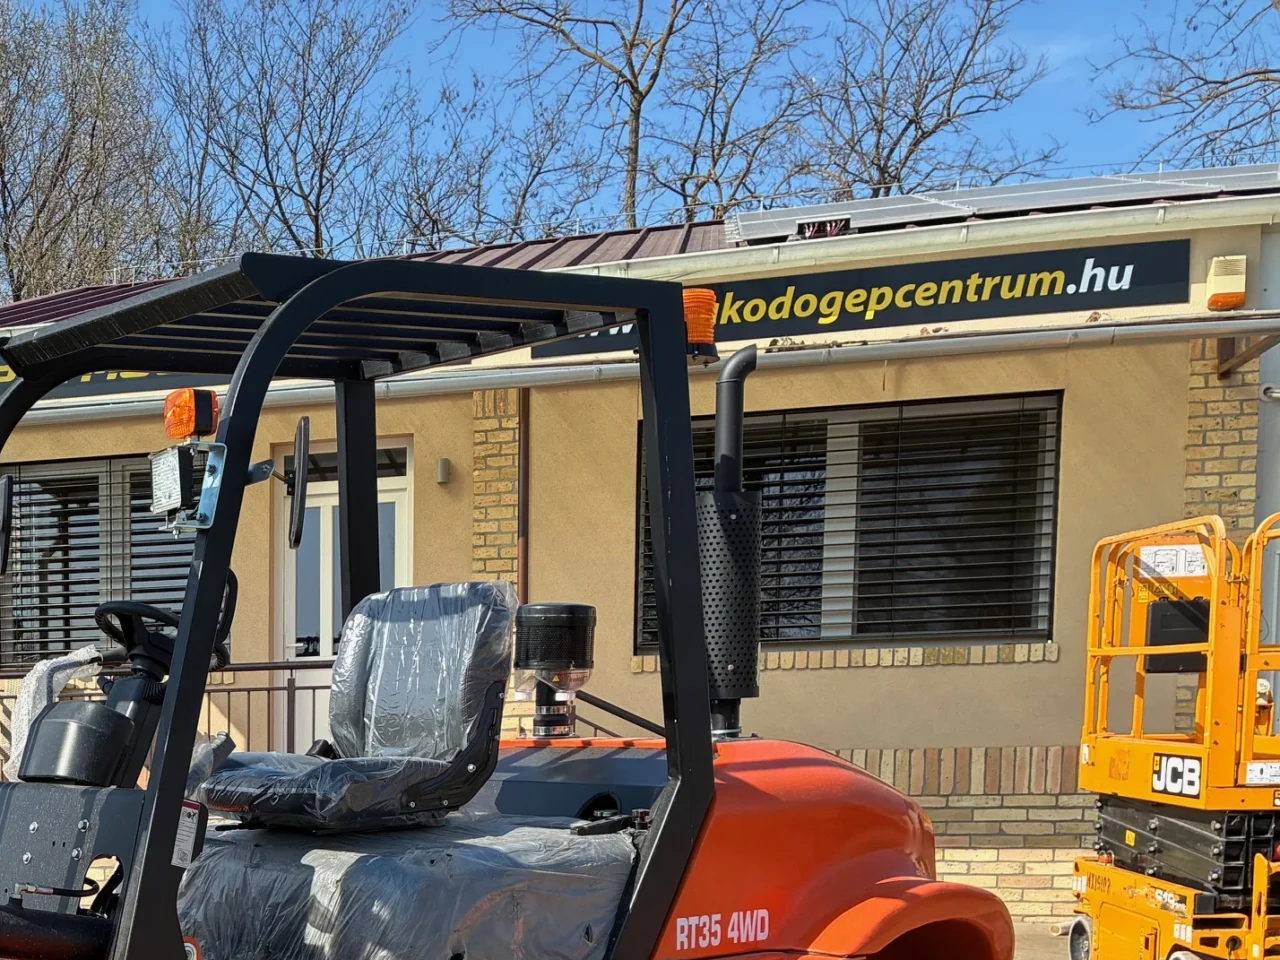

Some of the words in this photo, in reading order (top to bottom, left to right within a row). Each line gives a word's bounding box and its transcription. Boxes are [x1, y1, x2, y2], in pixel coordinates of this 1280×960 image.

[710, 257, 1135, 325] kodogepcentrum.hu
[1152, 755, 1201, 796] JCB
[676, 913, 722, 951] RT35
[727, 908, 770, 944] 4WD
